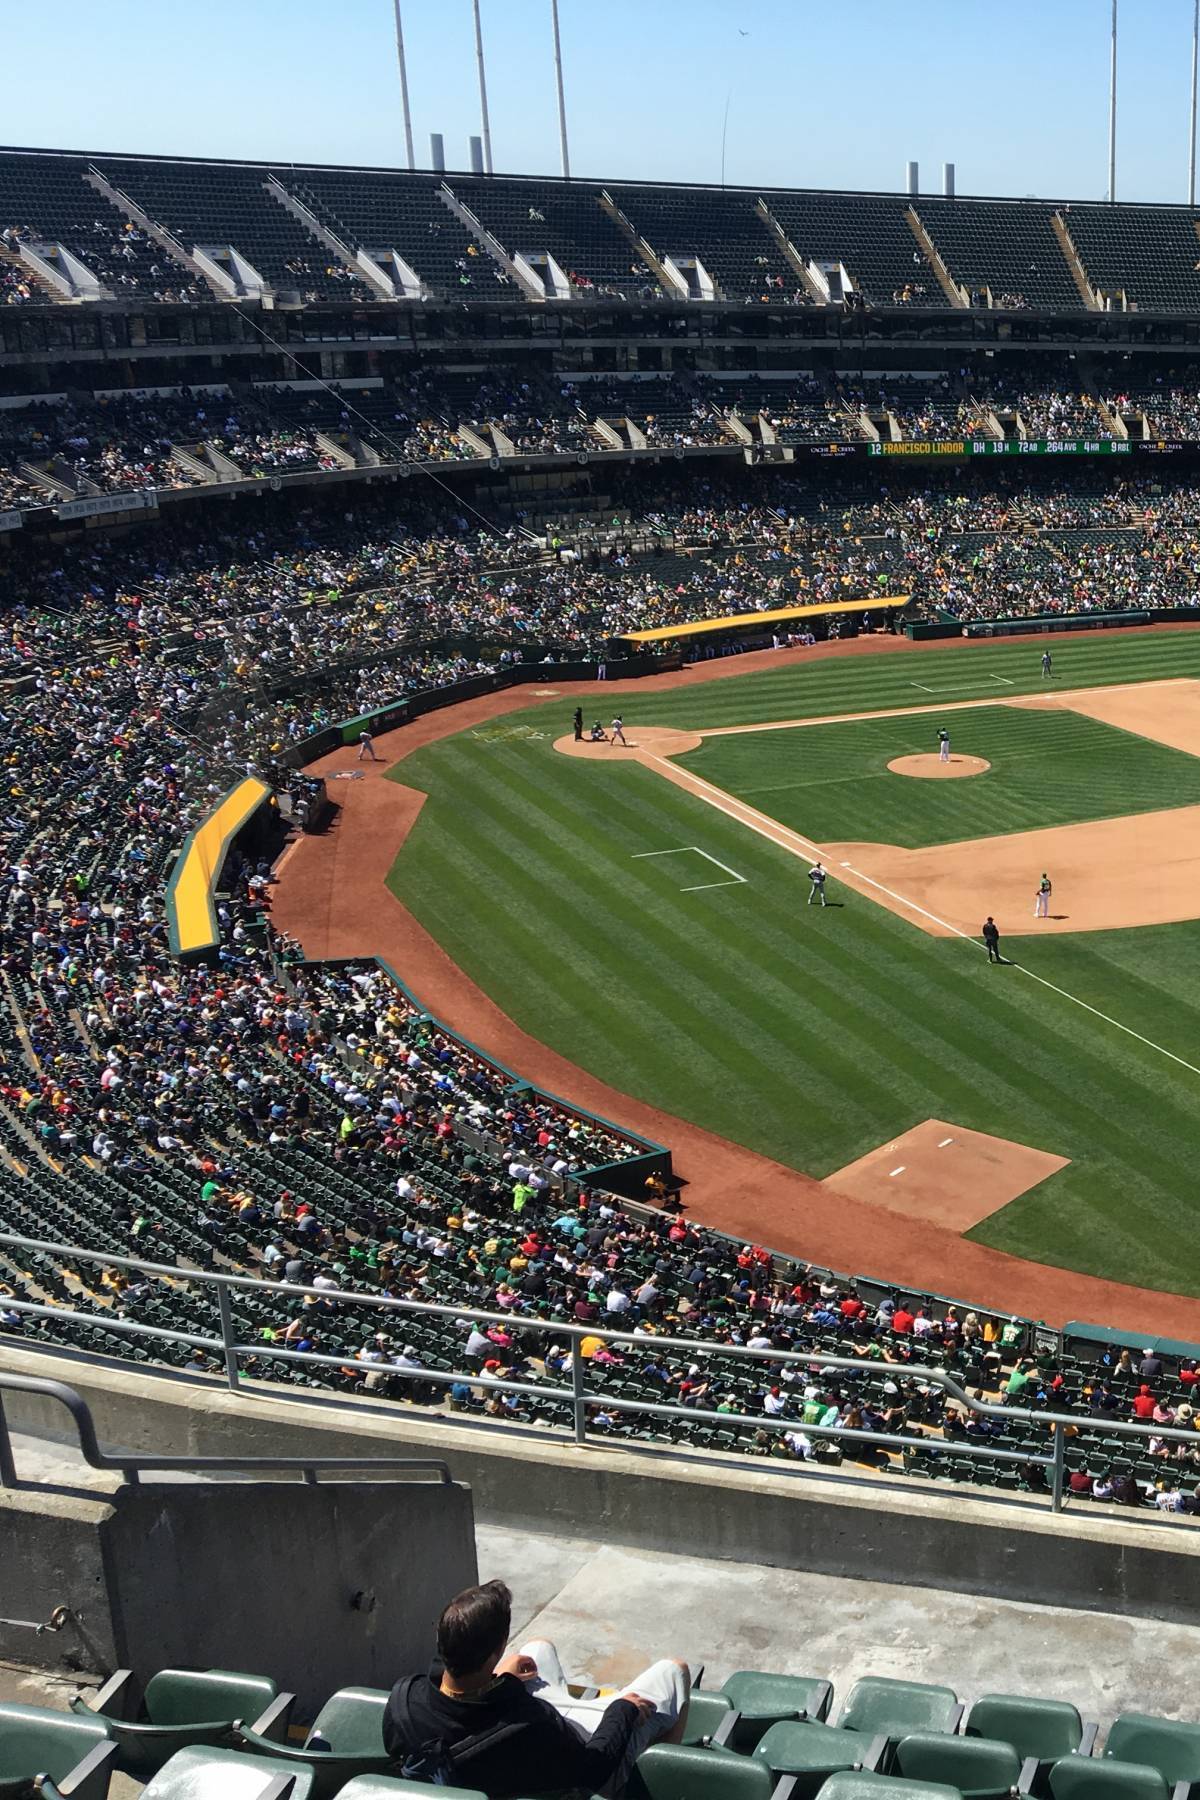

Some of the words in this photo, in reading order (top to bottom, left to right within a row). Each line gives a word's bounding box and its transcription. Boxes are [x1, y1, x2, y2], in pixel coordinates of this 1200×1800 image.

[871, 443, 882, 454] 12
[883, 442, 930, 454] FRANCISCO
[932, 442, 964, 454] LINDOR
[974, 442, 985, 453] DH
[993, 442, 1002, 453] 19
[1004, 1331, 1016, 1342] 26
